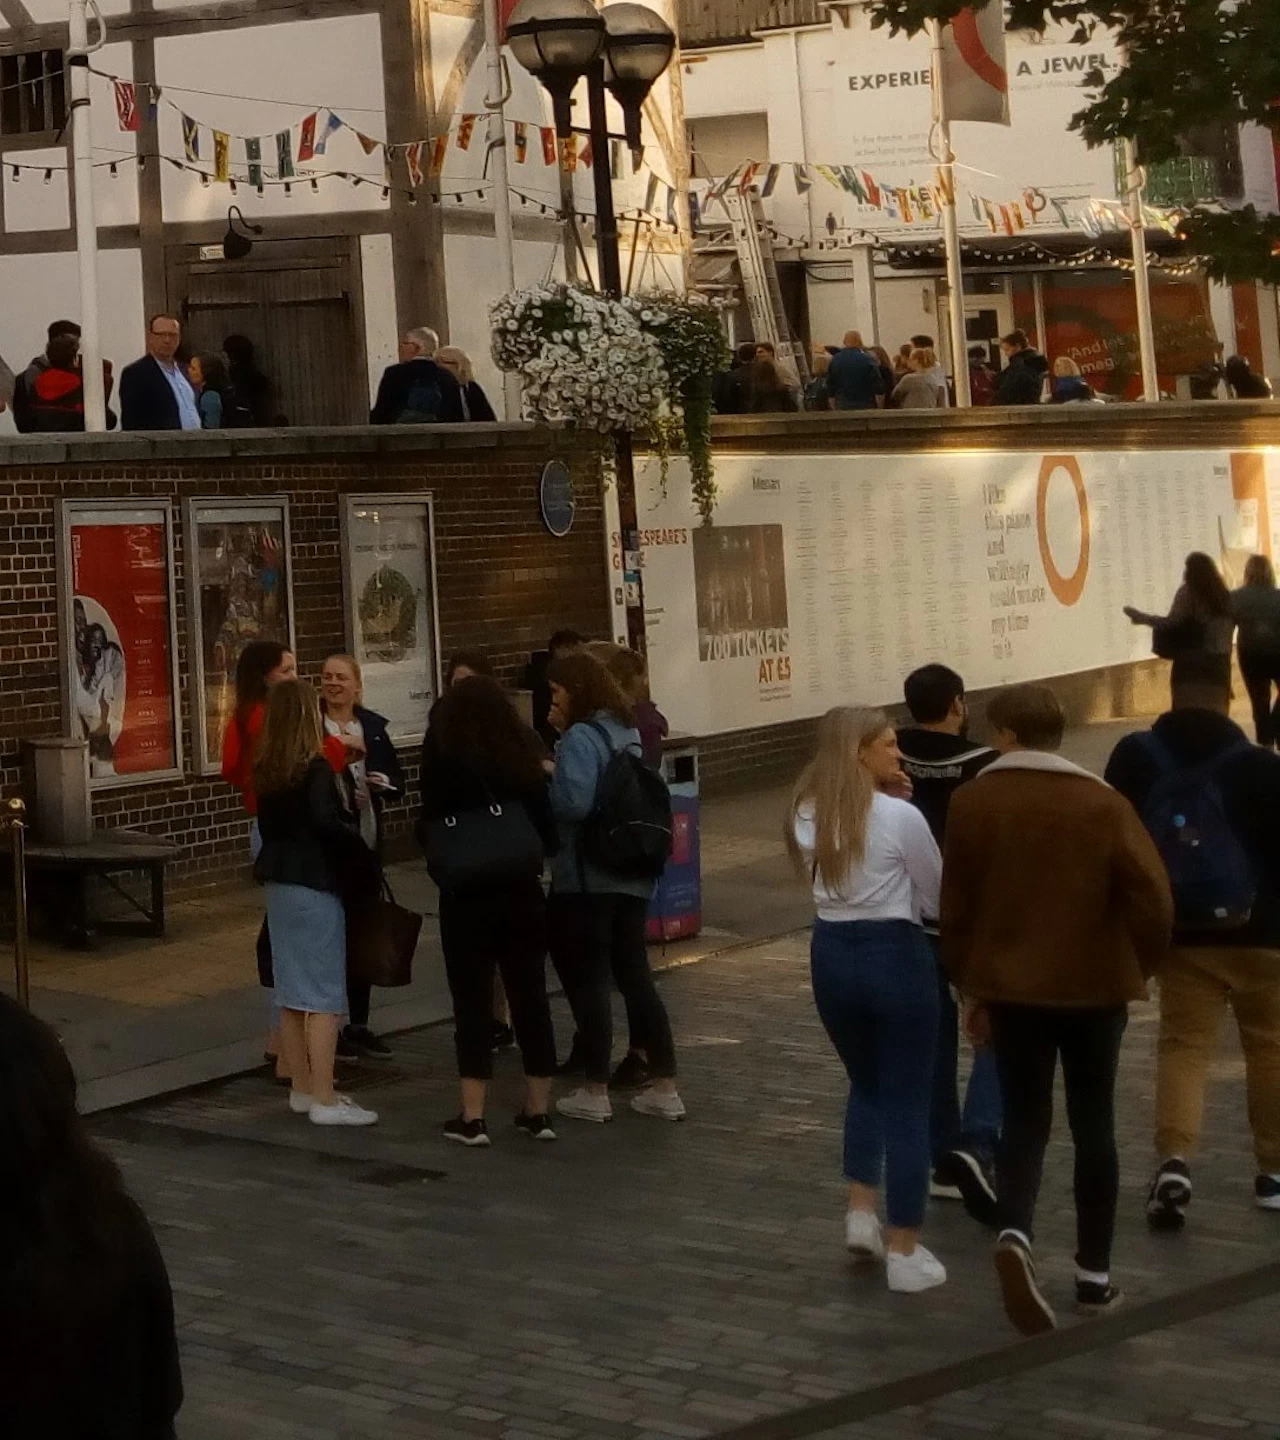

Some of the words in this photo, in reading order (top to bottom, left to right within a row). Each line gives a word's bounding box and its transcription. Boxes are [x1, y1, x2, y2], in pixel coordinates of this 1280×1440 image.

[848, 69, 931, 91] EXPERIE
[1017, 60, 1032, 76] A
[733, 627, 790, 658] TICKETS
[759, 658, 774, 683] AT
